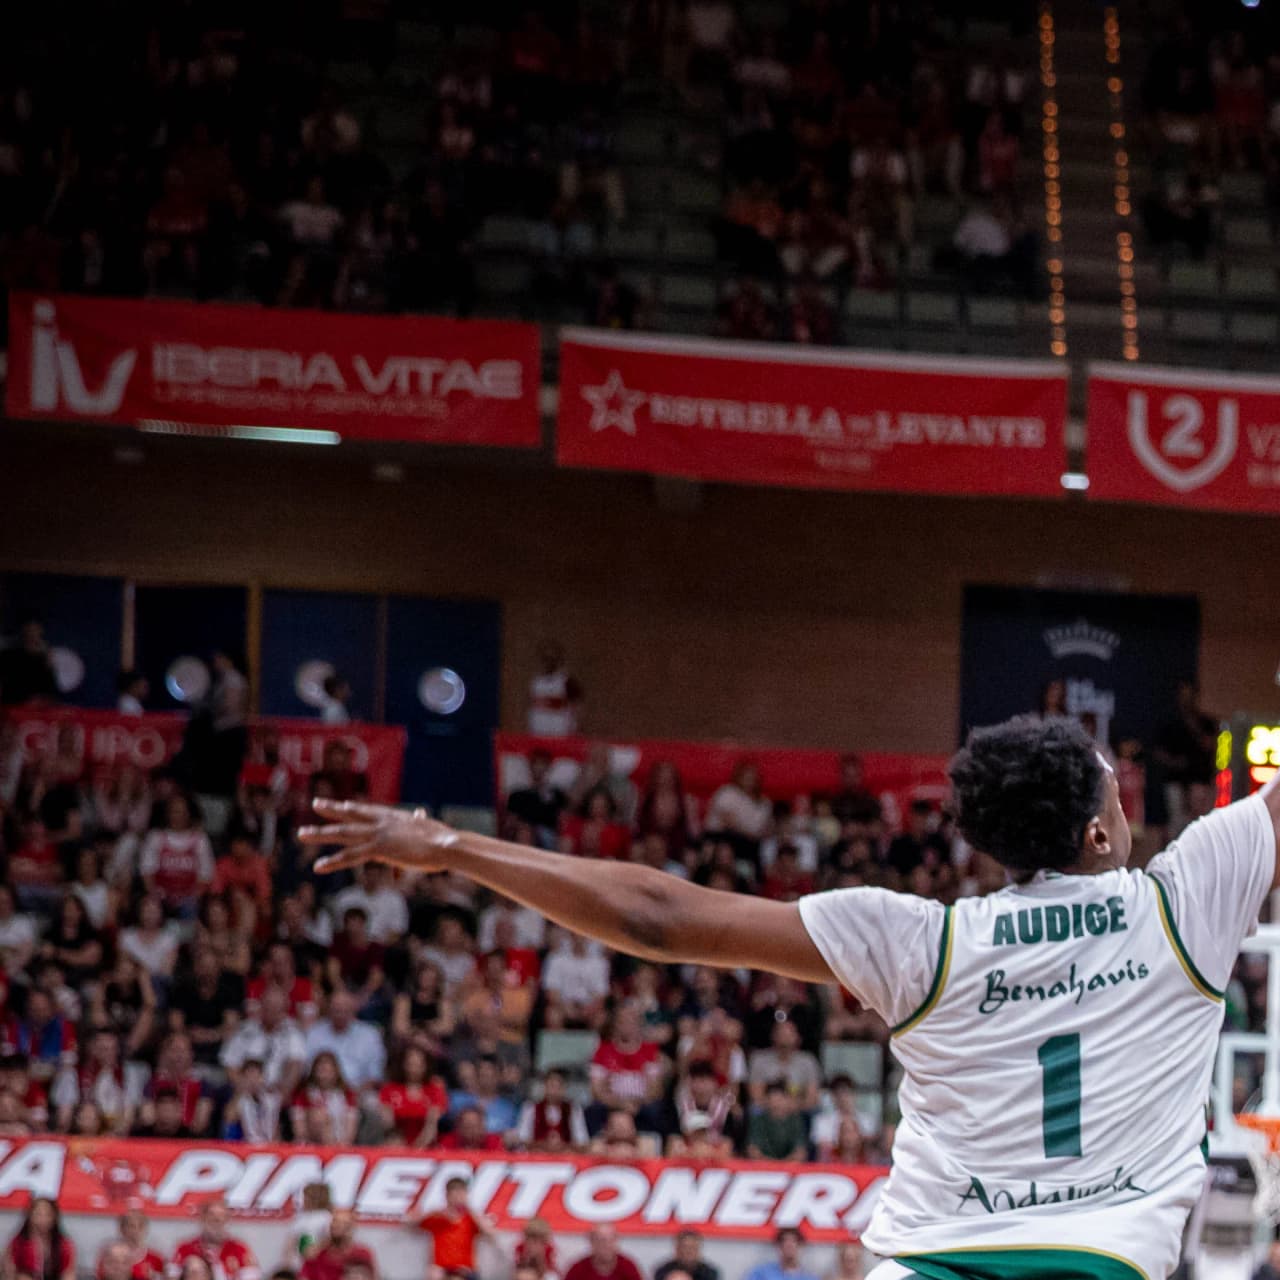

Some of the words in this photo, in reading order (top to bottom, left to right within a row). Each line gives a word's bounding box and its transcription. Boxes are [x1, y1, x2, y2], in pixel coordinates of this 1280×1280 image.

[152, 342, 346, 391] IBERIA
[352, 353, 523, 399] VITAE
[650, 393, 843, 442] ESTRELLA
[876, 410, 1046, 449] LEVANTE
[992, 896, 1128, 946] AUDIGE
[1037, 1032, 1082, 1158] 1
